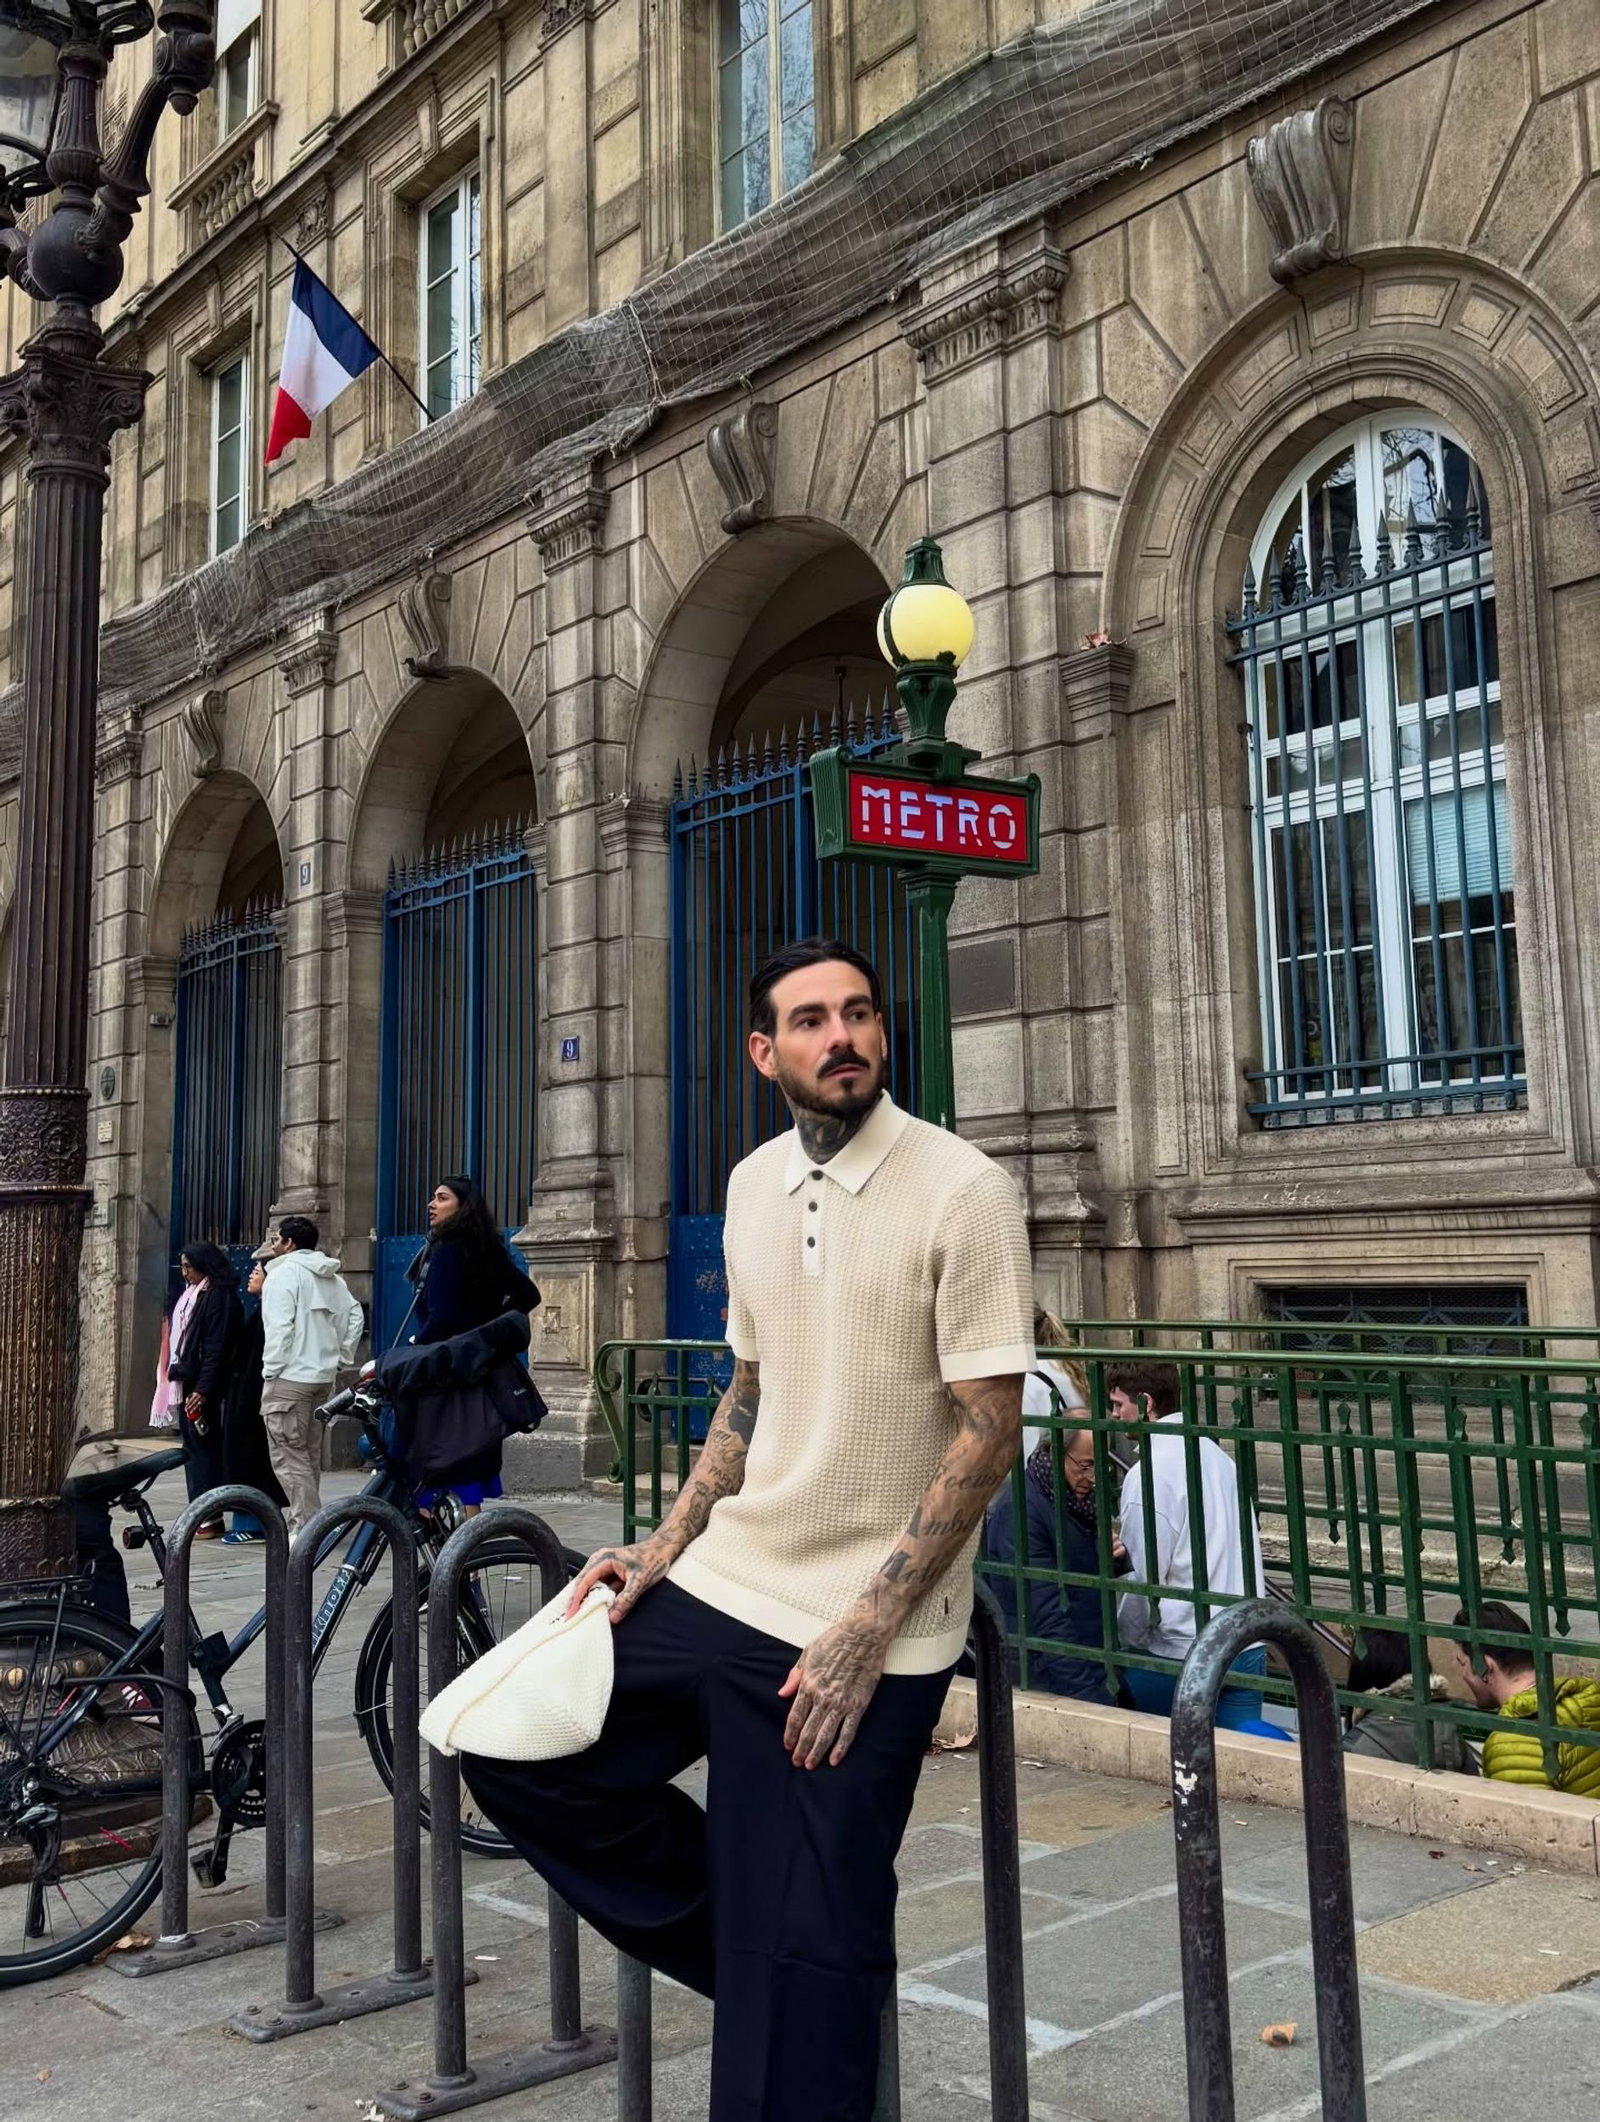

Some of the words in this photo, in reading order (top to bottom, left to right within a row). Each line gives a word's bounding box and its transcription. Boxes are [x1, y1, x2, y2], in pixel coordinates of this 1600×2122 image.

[862, 785, 1016, 850] METRO
[302, 865, 308, 884] 9
[566, 1040, 574, 1058] 9
